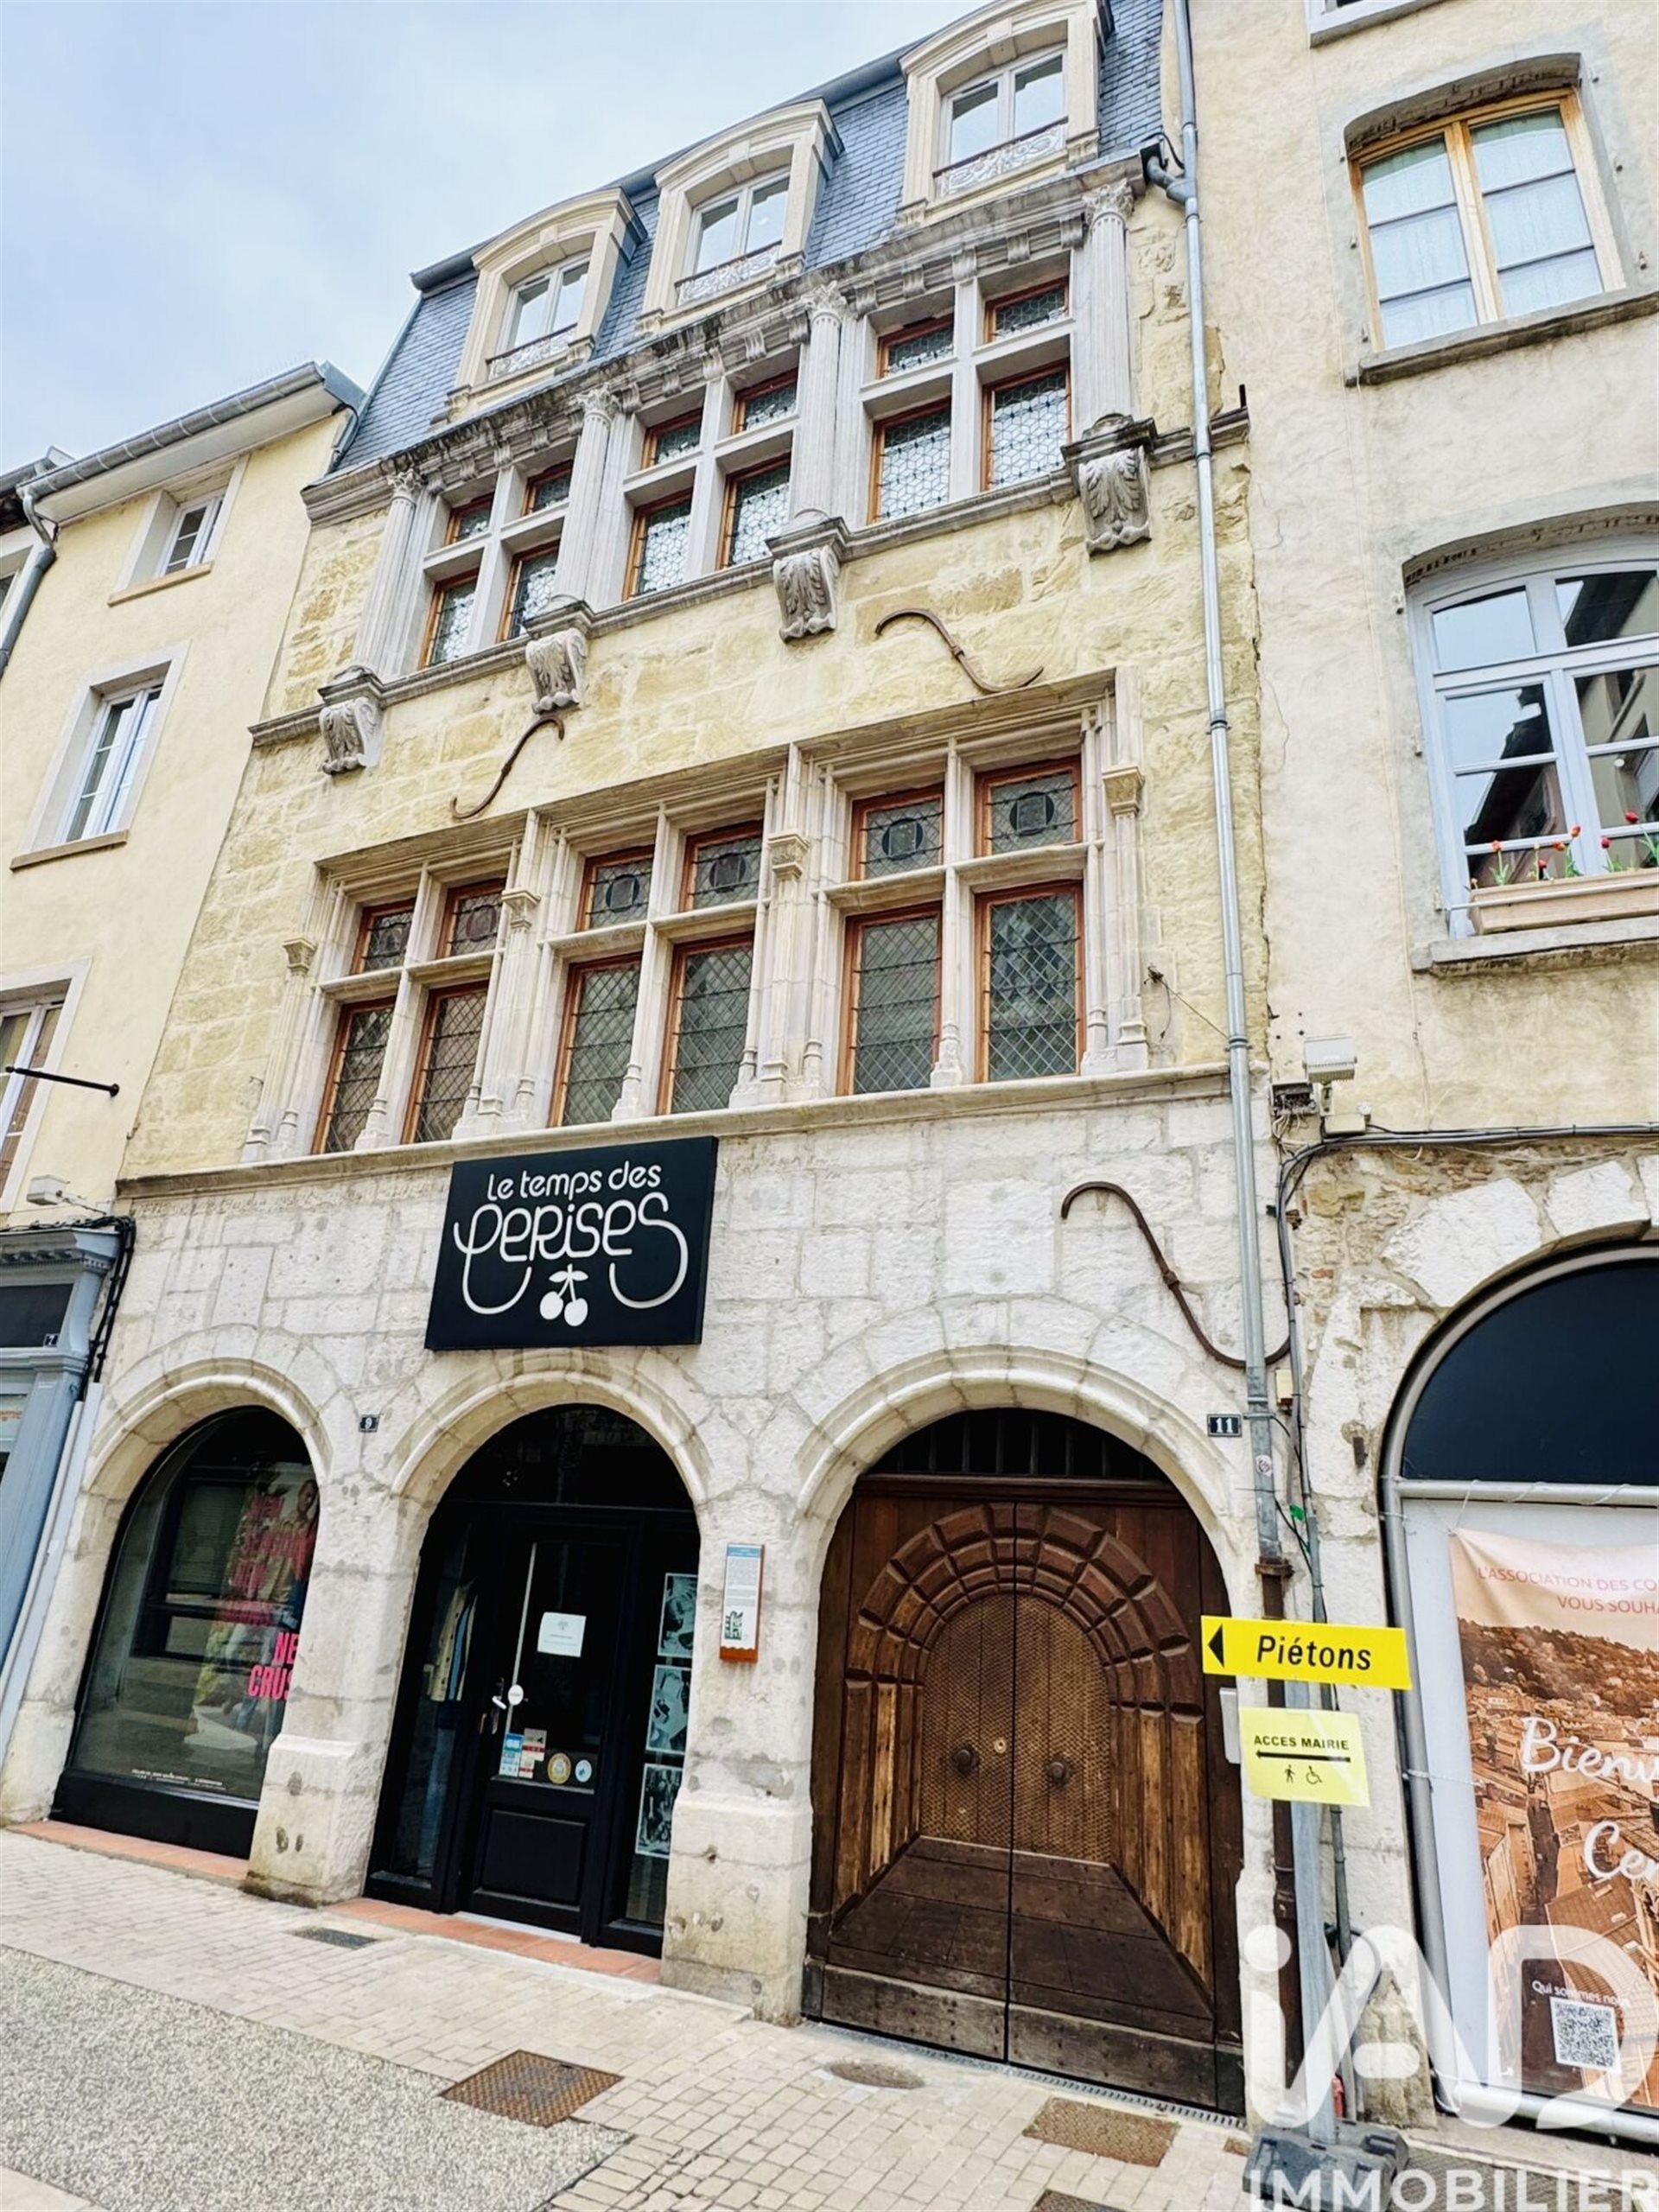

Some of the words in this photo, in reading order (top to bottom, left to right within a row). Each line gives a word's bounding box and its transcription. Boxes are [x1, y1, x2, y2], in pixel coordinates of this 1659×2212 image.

[487, 1173, 514, 1201] le
[520, 1170, 602, 1200] temps
[607, 1160, 662, 1191] des
[1216, 1418, 1233, 1433] 11
[1478, 1567, 1592, 1588] L'ASSOCIATION
[1598, 1579, 1629, 1591] DES
[1557, 1596, 1604, 1611] VOUS
[1609, 1599, 1659, 1615] SOUH
[1257, 1635, 1371, 1671] Piétons
[1254, 1735, 1297, 1748] ACCES
[1301, 1737, 1350, 1751] MAIRIE
[1532, 1980, 1552, 1995] Qui
